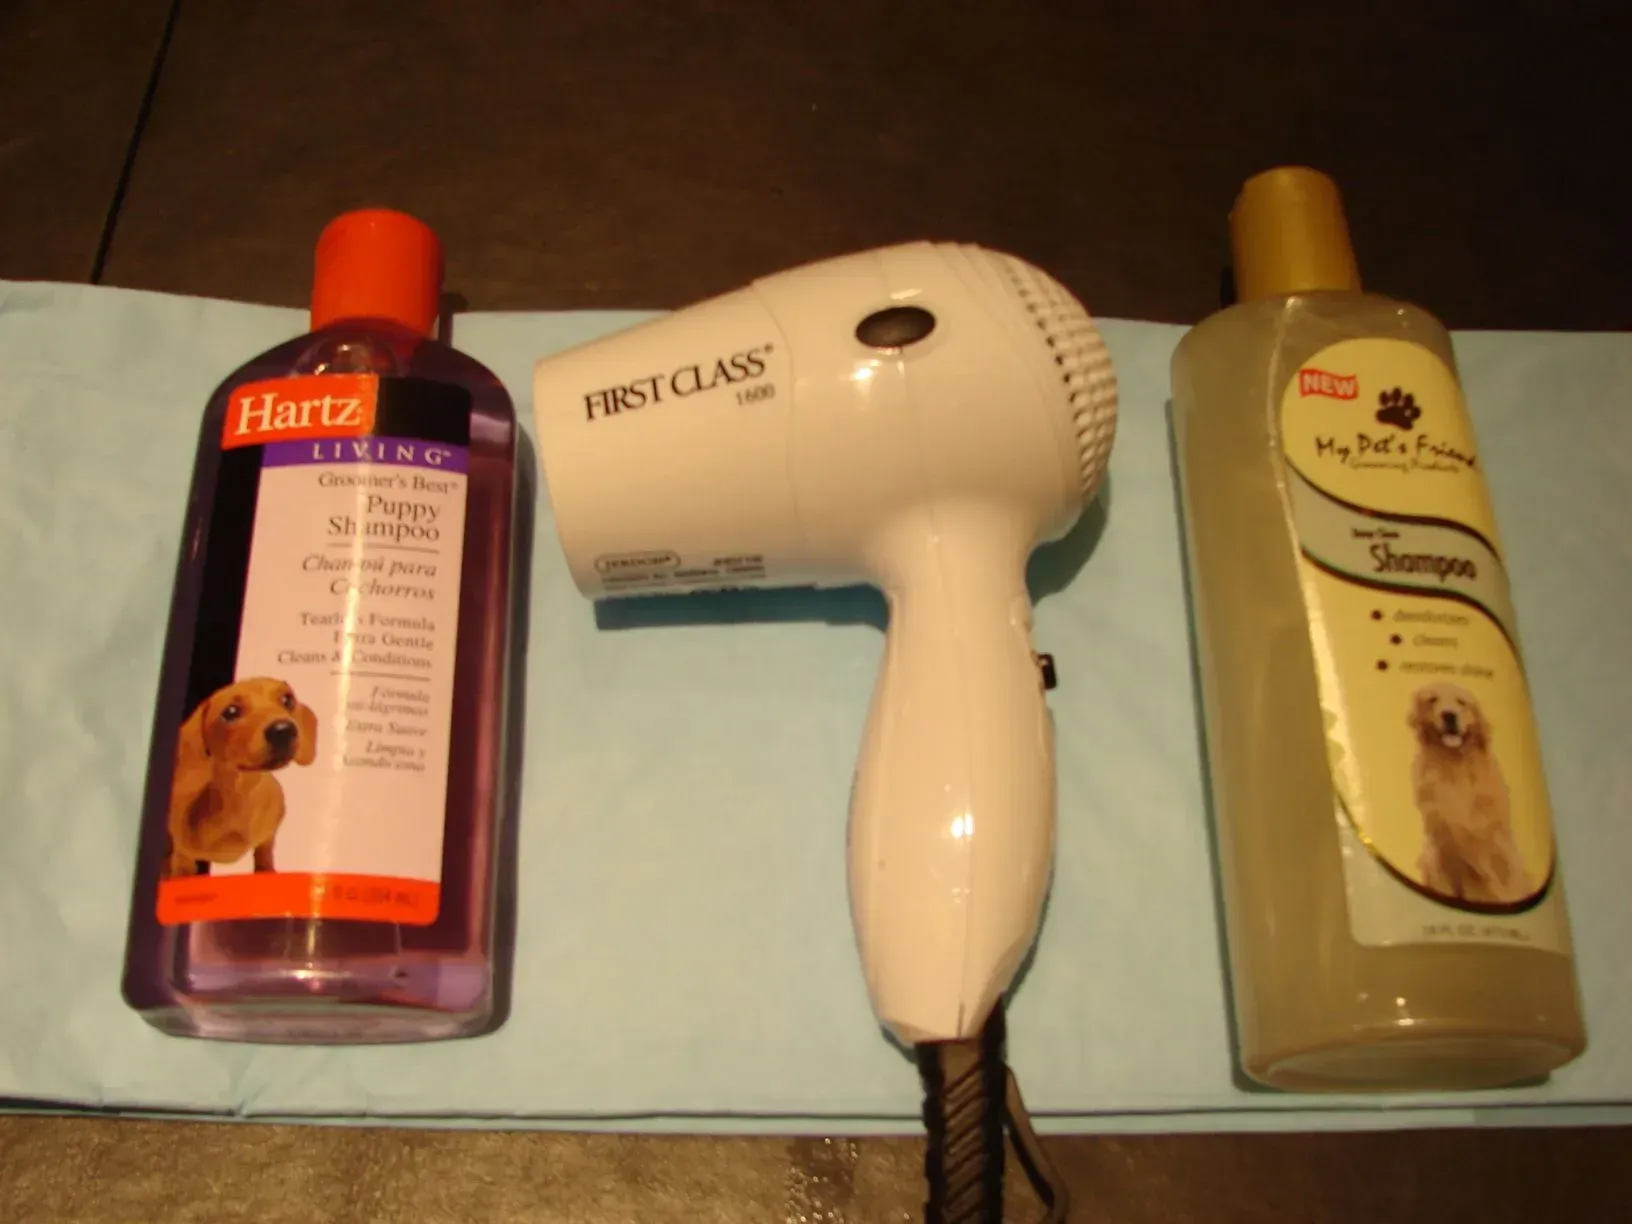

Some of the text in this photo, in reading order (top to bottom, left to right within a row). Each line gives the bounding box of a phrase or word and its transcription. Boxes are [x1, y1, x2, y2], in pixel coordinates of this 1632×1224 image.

[736, 383, 776, 406] 1600
[1302, 372, 1355, 397] NEW
[583, 374, 665, 422] FIRST
[234, 391, 362, 436] Hartz
[311, 441, 446, 465] LIVING
[1315, 436, 1351, 464] My
[1357, 432, 1407, 458] Pet's
[317, 470, 408, 490] Groomer's
[366, 494, 441, 524] Puppy
[388, 558, 438, 578] para
[1369, 542, 1478, 583] Shampoo
[329, 577, 436, 601] Cchorros
[300, 611, 436, 632] Tearls Formula
[333, 630, 434, 651] Etra Gentle
[277, 649, 326, 665] Cleans
[351, 650, 432, 669] Conditions
